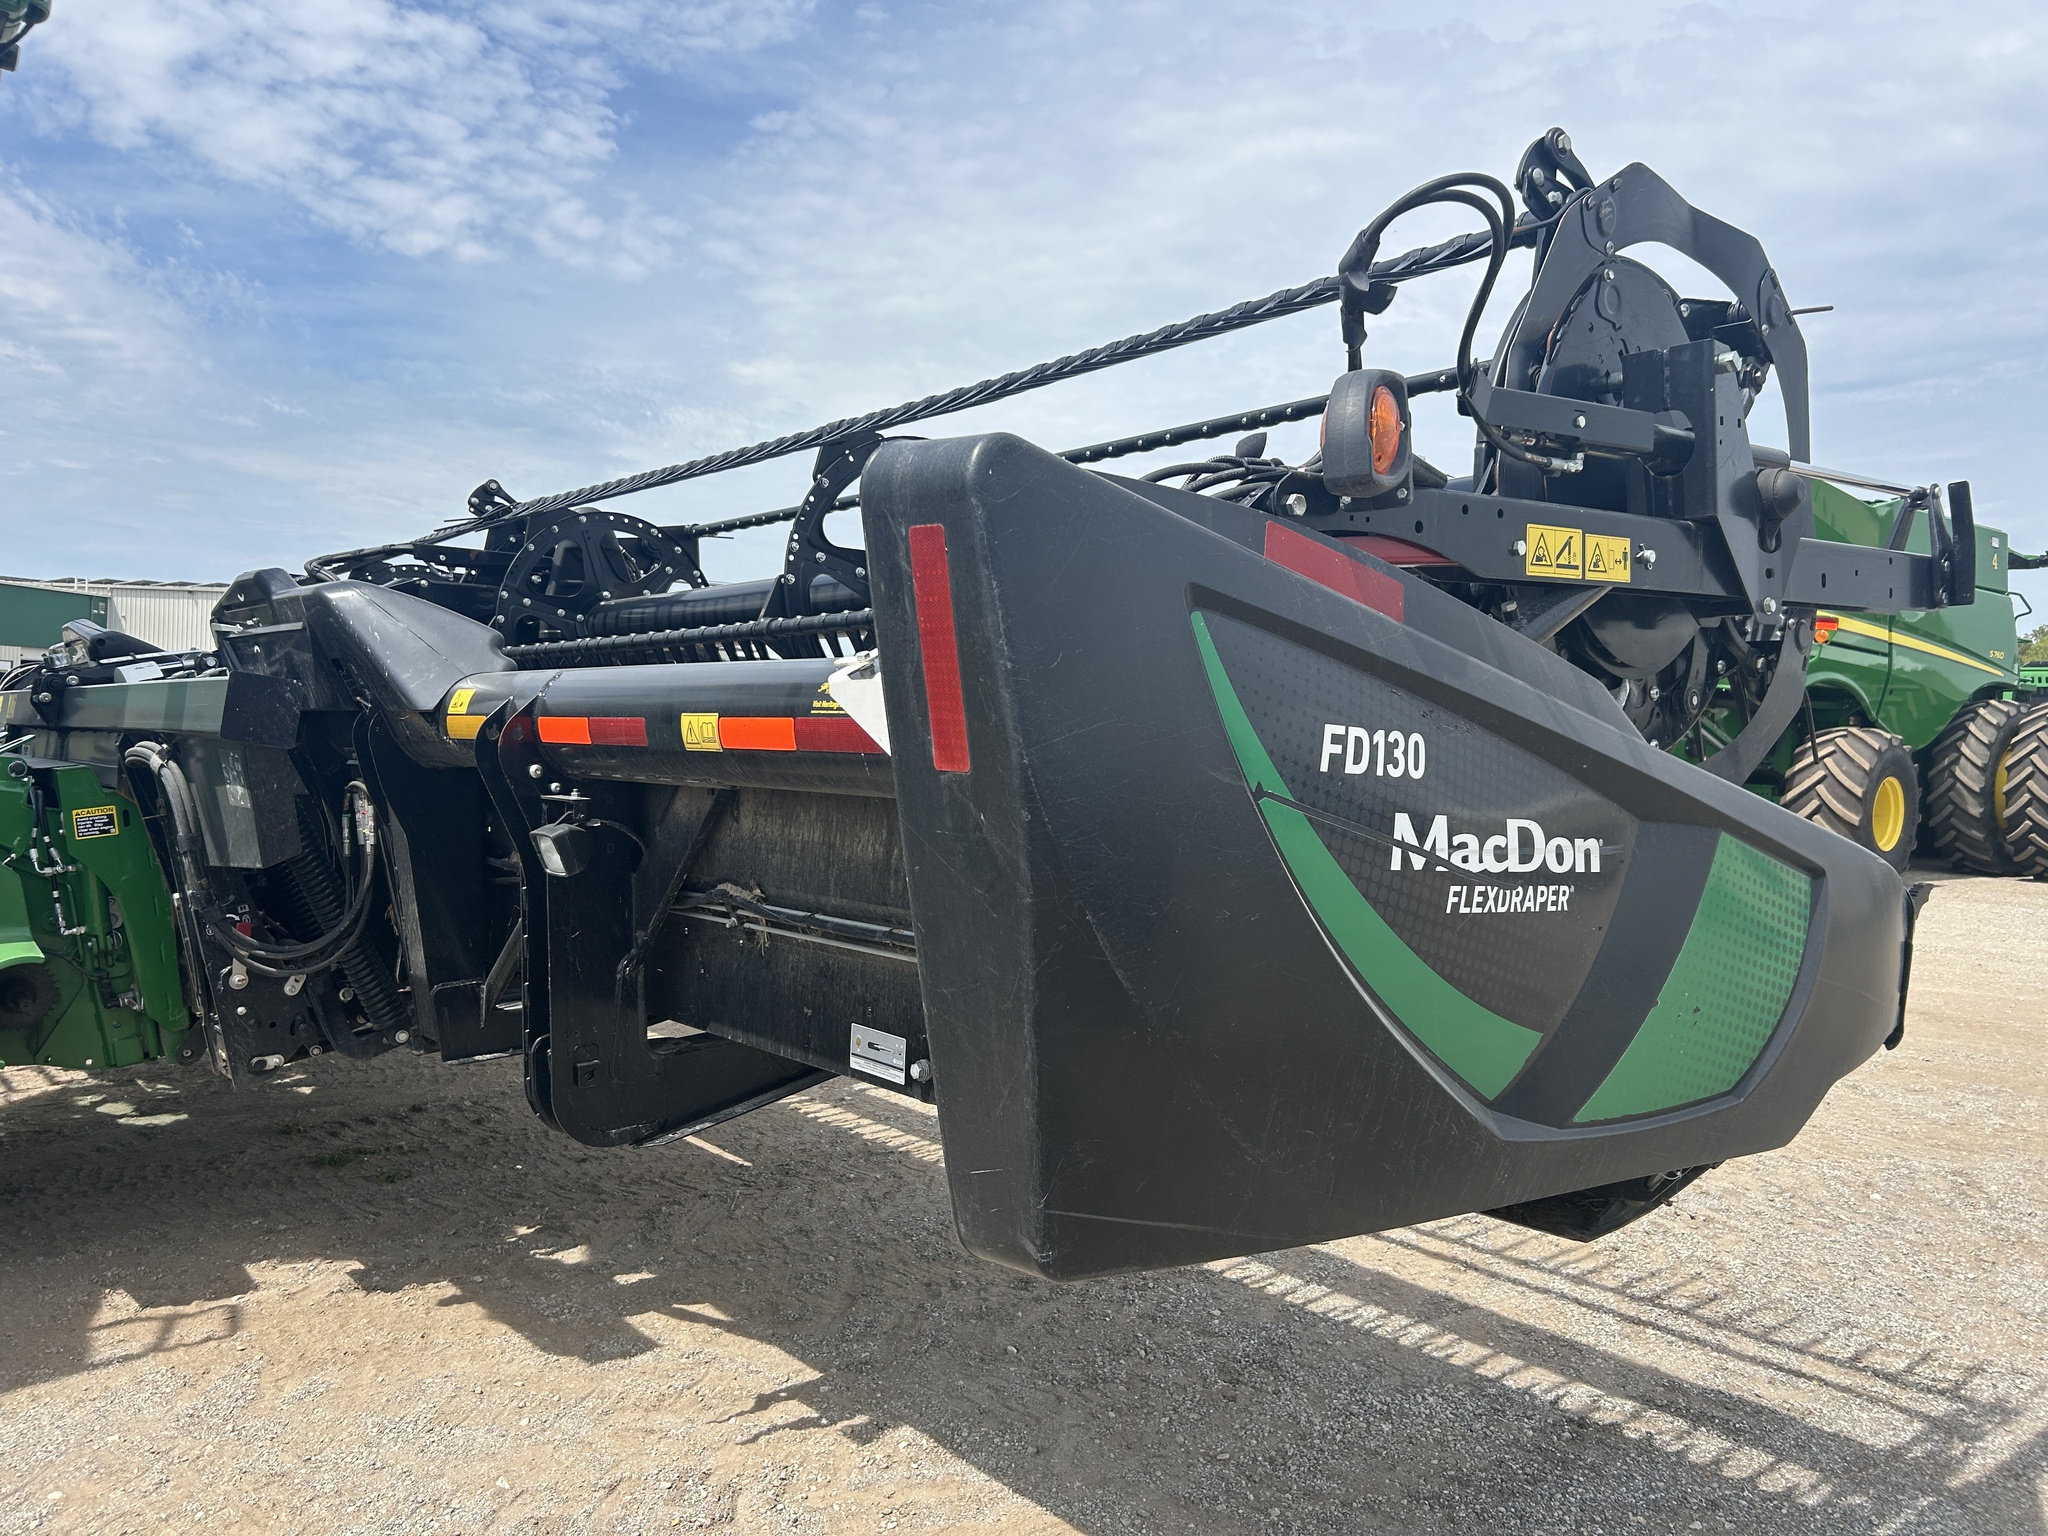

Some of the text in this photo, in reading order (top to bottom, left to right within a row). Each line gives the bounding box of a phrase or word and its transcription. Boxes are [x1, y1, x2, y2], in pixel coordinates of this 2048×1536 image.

[1992, 553, 1998, 570] 4
[1989, 649, 2005, 660] S760
[1319, 723, 1426, 780] FD130
[80, 807, 114, 816] CAUTION
[1390, 812, 1601, 874] MacDon
[1445, 885, 1572, 914] FLEXDRAPER
